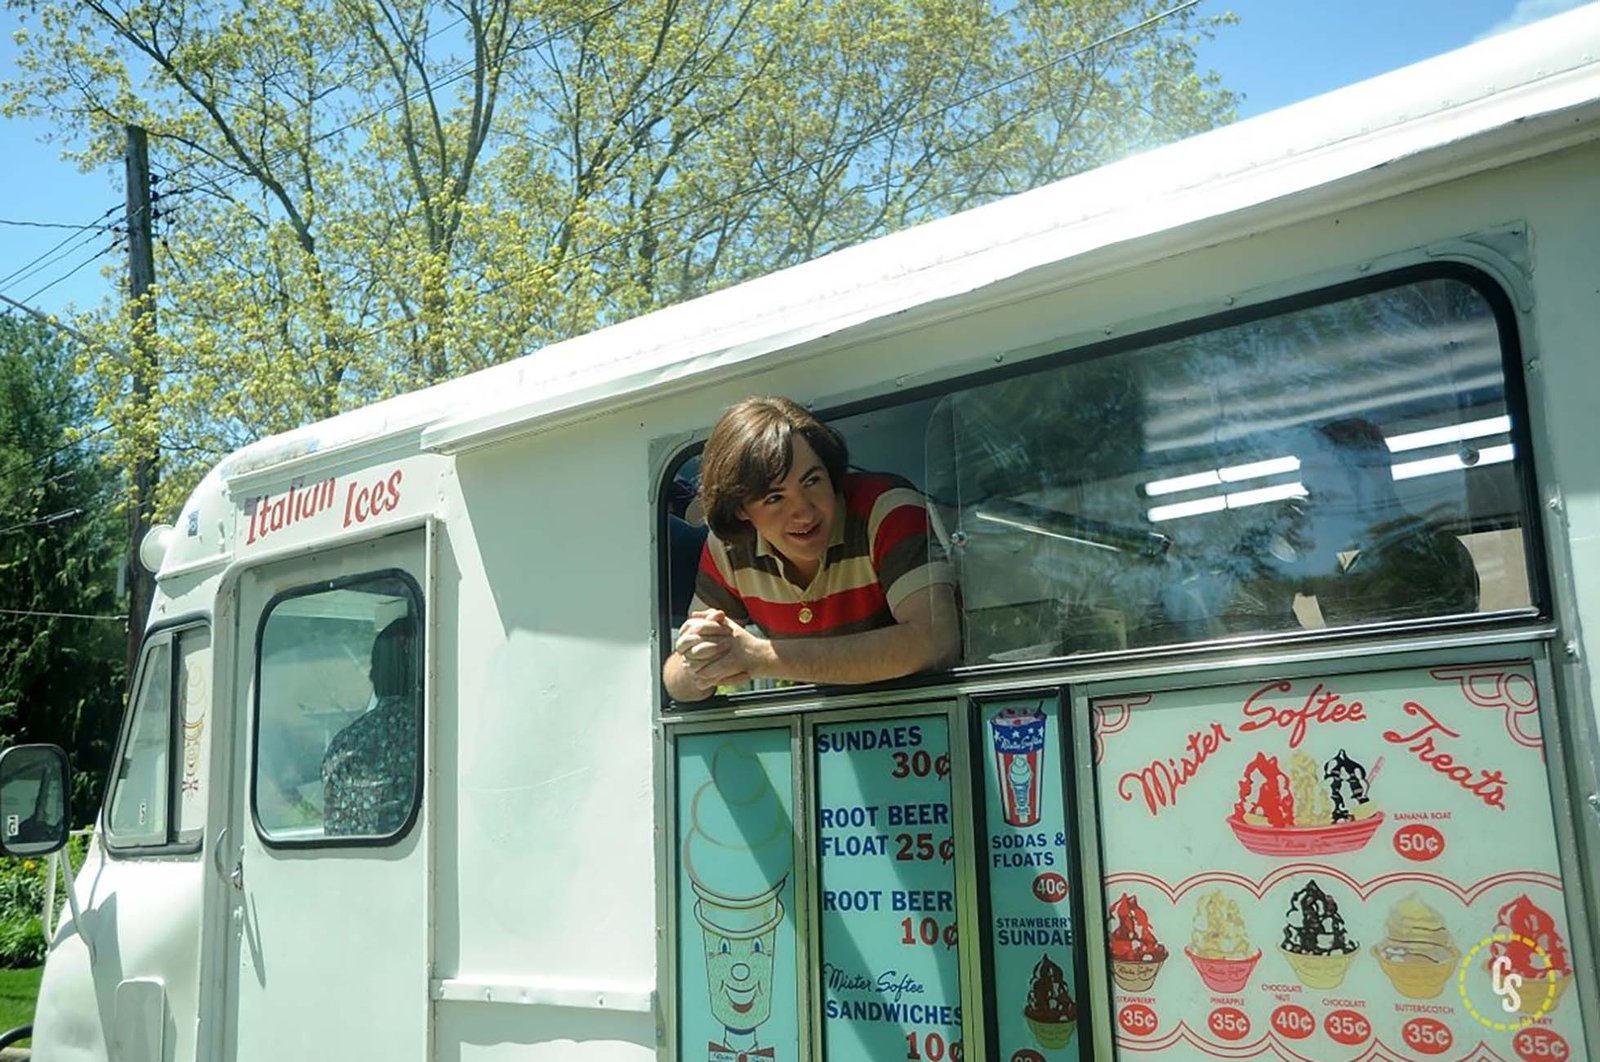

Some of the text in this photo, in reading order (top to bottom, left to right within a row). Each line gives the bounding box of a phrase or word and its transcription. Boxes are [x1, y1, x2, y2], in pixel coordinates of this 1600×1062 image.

[246, 477, 336, 545] Italian
[343, 470, 402, 528] Ices
[818, 726, 922, 753] SUNDAES
[1118, 681, 1508, 816] Mister Softee Treats
[891, 750, 951, 781] 30¢
[821, 803, 948, 829] ROOT BEER
[1394, 812, 1429, 820] BANANA
[821, 834, 889, 857] FLOAT
[992, 832, 1067, 849] SODAS &
[1399, 832, 1439, 853] 50¢
[993, 852, 1054, 868] FLOATS
[1036, 879, 1066, 896] 40¢
[824, 890, 953, 912] ROOT BEER
[999, 929, 1072, 946] SUNDAE
[823, 962, 925, 1002] Mister Softee
[827, 1000, 961, 1026] SANDWICHES
[1322, 998, 1366, 1008] CHOCOLATE
[1394, 1003, 1455, 1015] BUTTERSCOTCH
[1122, 1009, 1156, 1028] 35¢
[1212, 1012, 1248, 1033] 35¢
[1276, 1011, 1313, 1031] 40¢
[1329, 1015, 1369, 1037] 35¢
[1407, 1024, 1450, 1047] 35¢
[1519, 1034, 1566, 1059] 35¢
